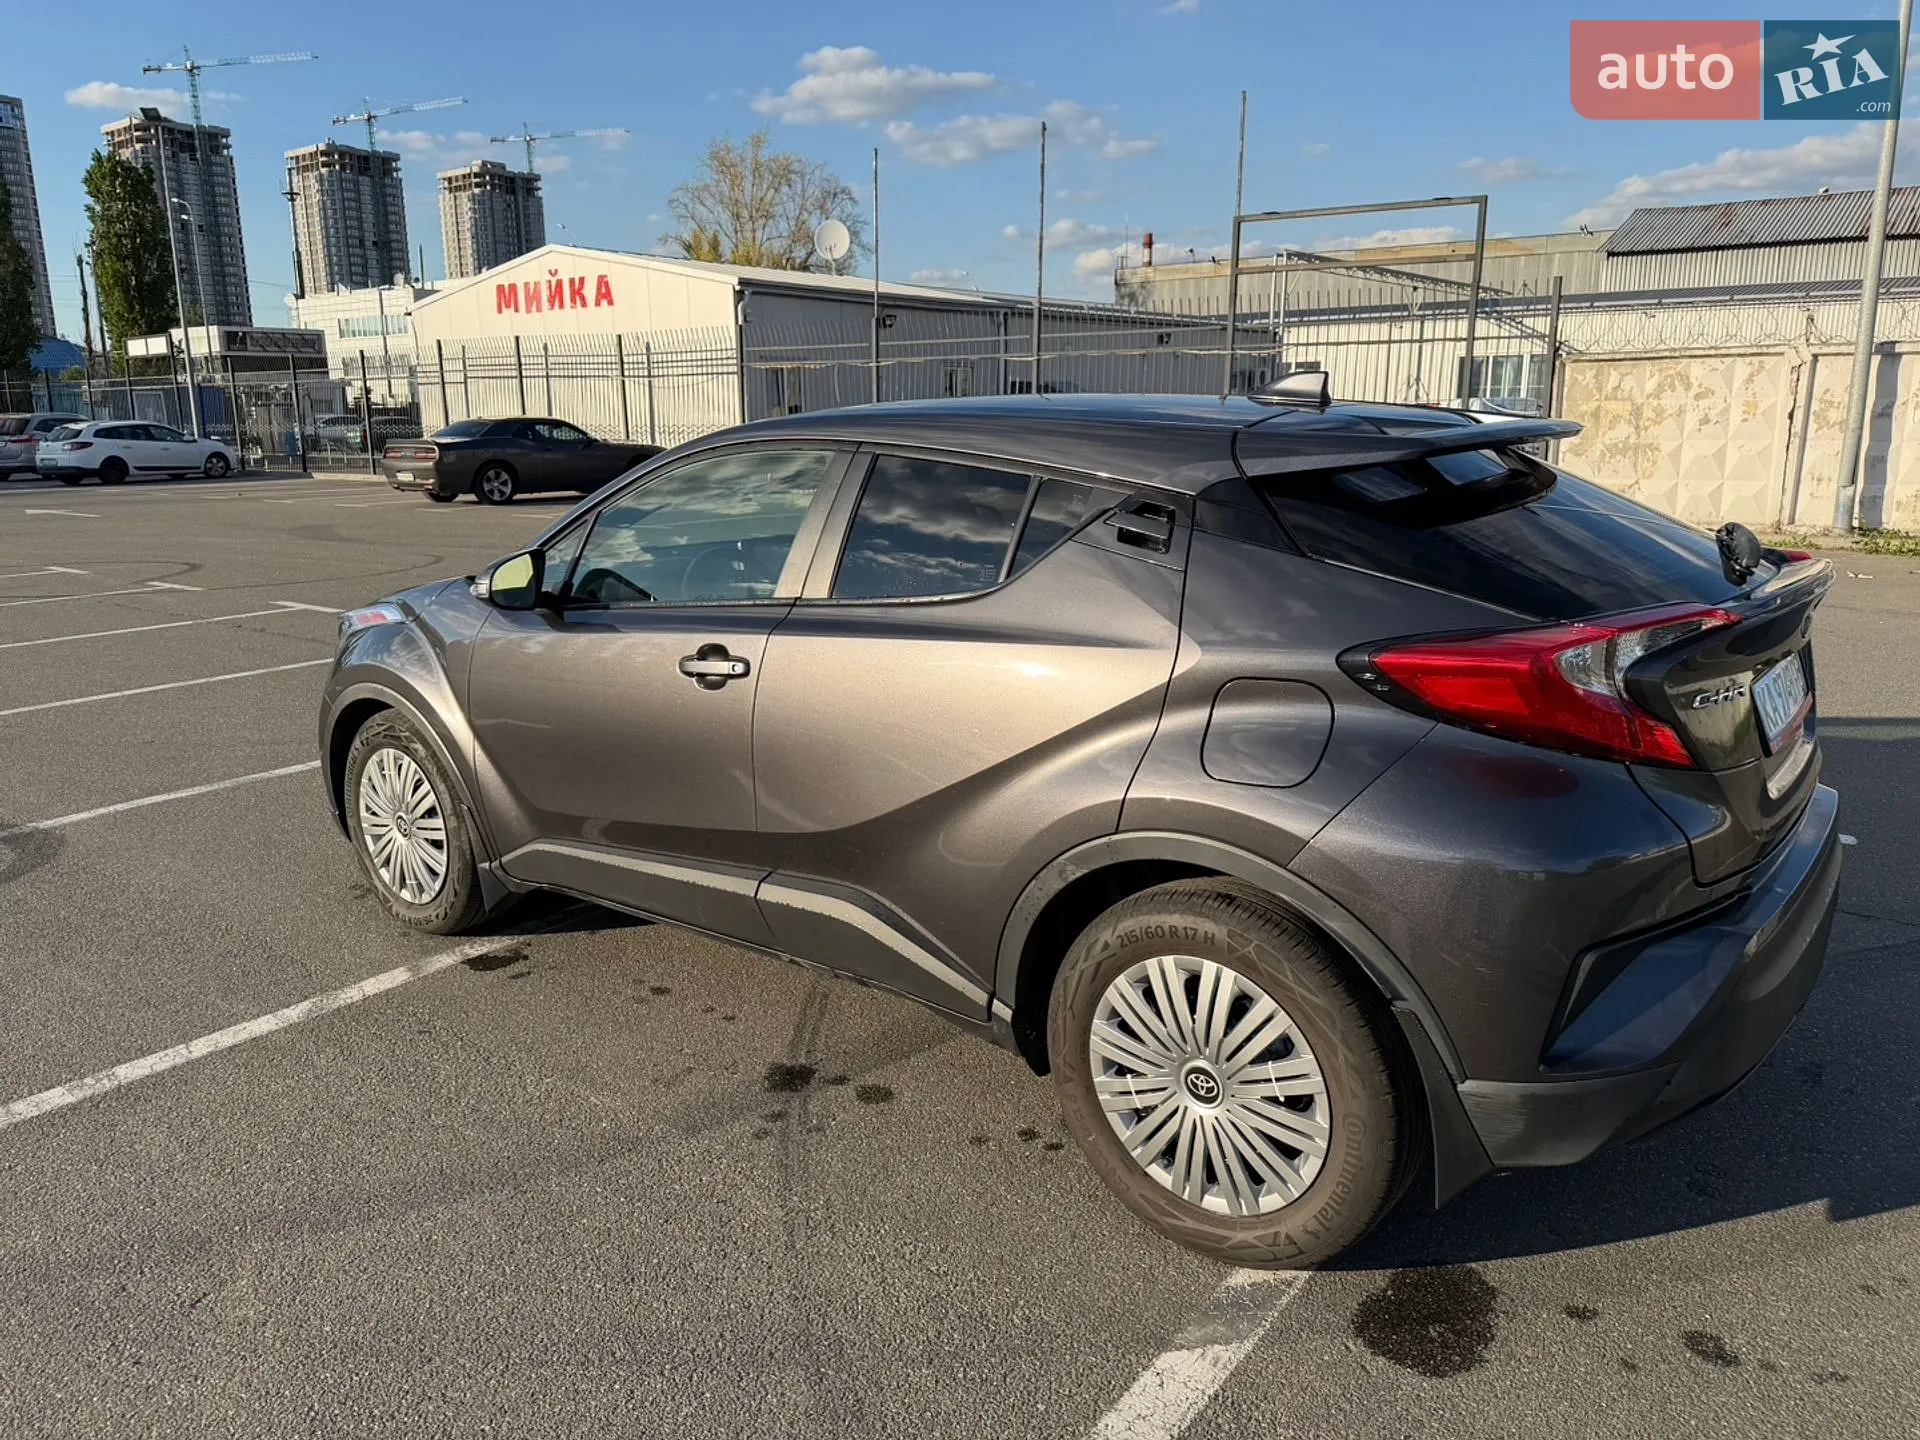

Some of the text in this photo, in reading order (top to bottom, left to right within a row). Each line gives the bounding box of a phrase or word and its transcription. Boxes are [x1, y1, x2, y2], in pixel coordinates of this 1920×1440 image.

[495, 269, 615, 314] МИЙКА
[1116, 924, 1216, 948] 215/60 R 17 H
[1314, 1112, 1367, 1232] Continental
